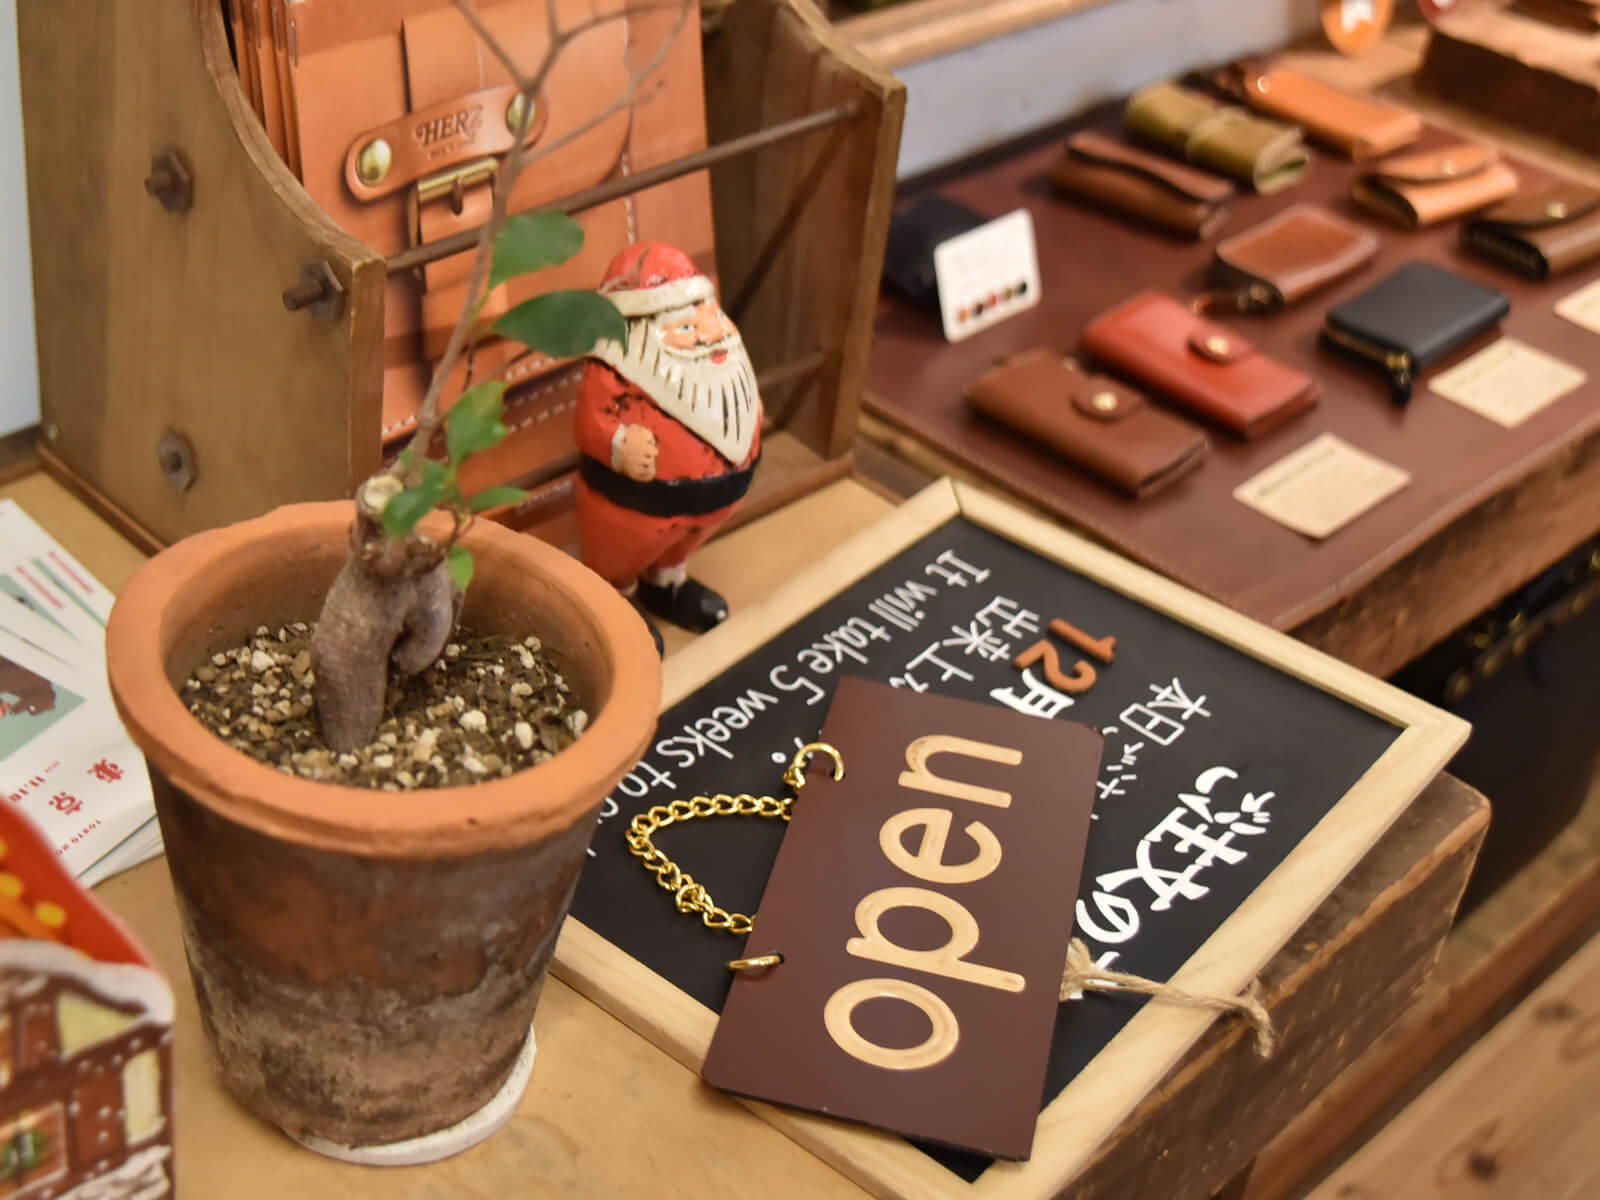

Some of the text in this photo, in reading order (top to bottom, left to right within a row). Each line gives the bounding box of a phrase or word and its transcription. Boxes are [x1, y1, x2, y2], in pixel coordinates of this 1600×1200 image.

[415, 105, 483, 146] HERZ
[925, 550, 991, 587] It
[868, 580, 937, 632] will
[797, 617, 892, 674] take
[769, 665, 825, 706] 5
[655, 689, 779, 767] weeks
[617, 760, 677, 797] to
[1070, 766, 1275, 985] ご注文の
[823, 733, 1026, 1071] open
